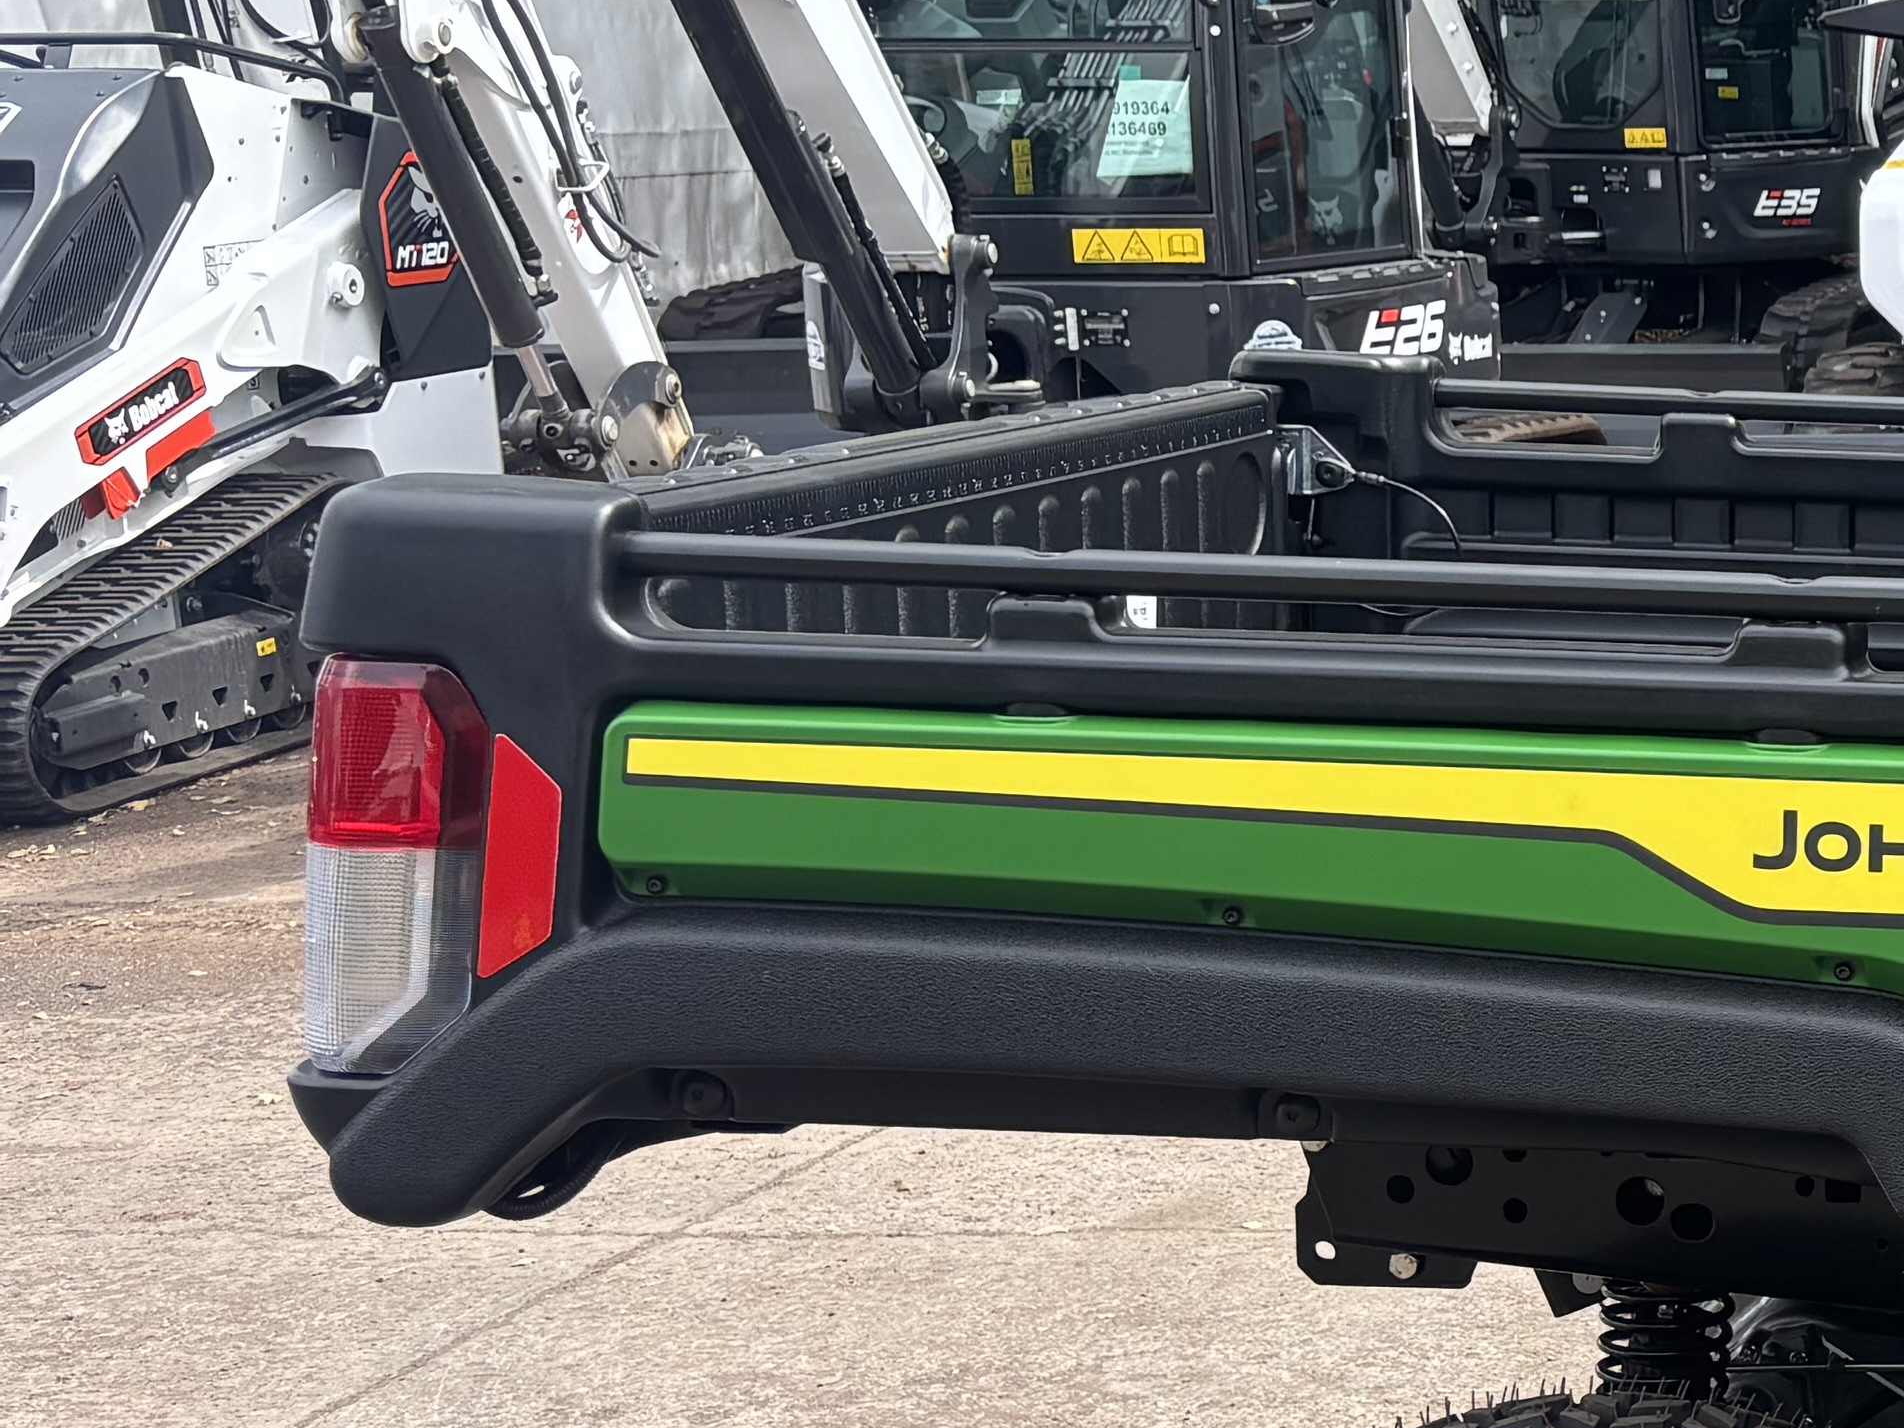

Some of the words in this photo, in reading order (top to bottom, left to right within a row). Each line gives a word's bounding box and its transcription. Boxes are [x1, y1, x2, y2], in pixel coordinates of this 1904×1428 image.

[1753, 187, 1821, 217] E35
[396, 240, 450, 270] MT120
[1359, 299, 1447, 356] E26
[128, 381, 180, 433] Bobcat
